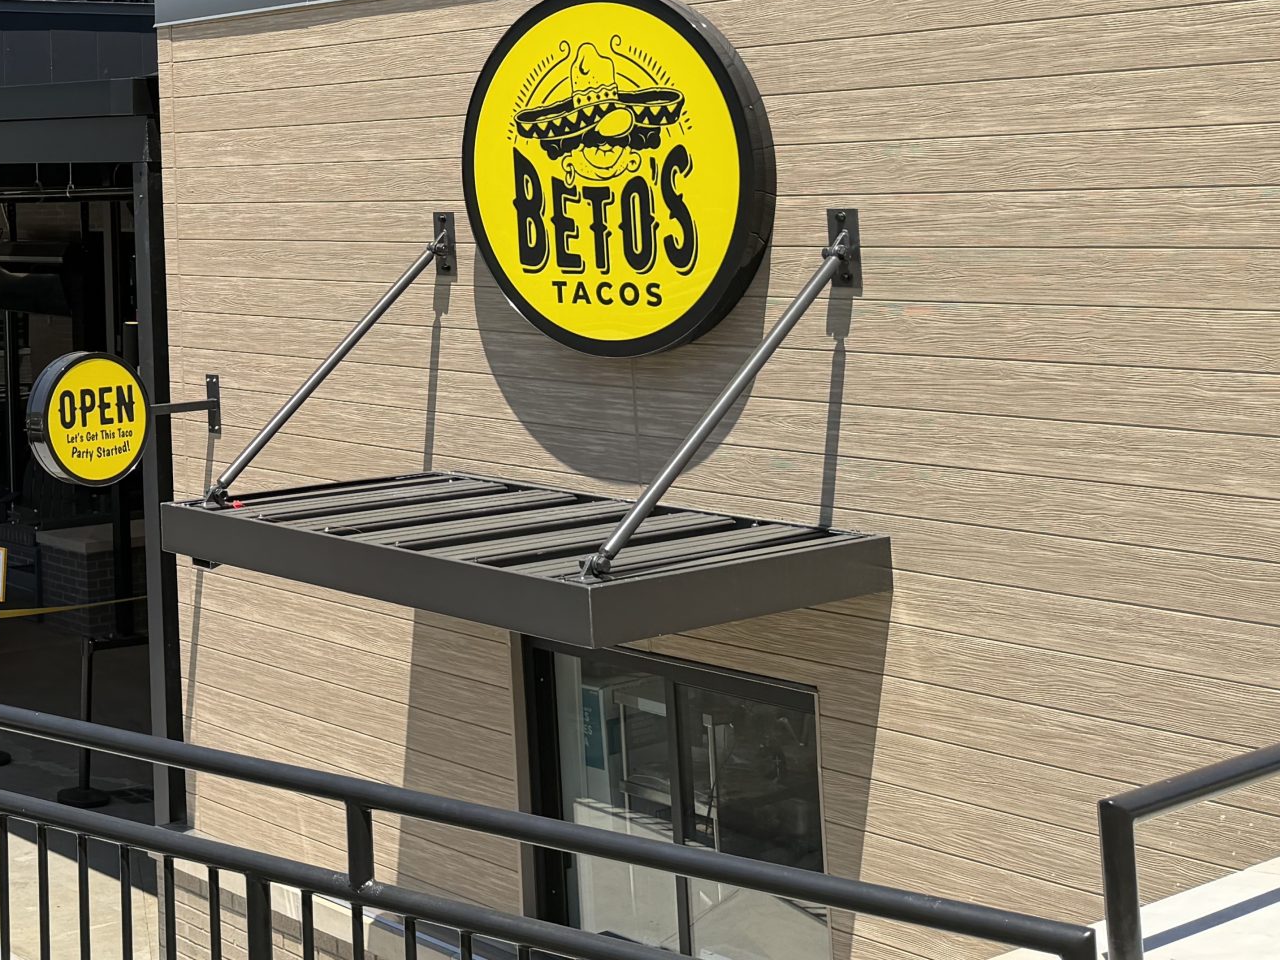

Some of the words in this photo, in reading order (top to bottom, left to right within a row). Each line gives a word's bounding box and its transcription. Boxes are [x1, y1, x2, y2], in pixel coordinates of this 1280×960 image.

[512, 144, 699, 276] BETO'S
[551, 280, 663, 307] TACOS
[58, 384, 135, 429] OPEN
[66, 432, 84, 443] Let's
[86, 431, 98, 442] Get
[100, 430, 115, 440] This
[117, 428, 133, 438] Taco
[71, 447, 93, 462] Party
[96, 440, 130, 458] Started!
